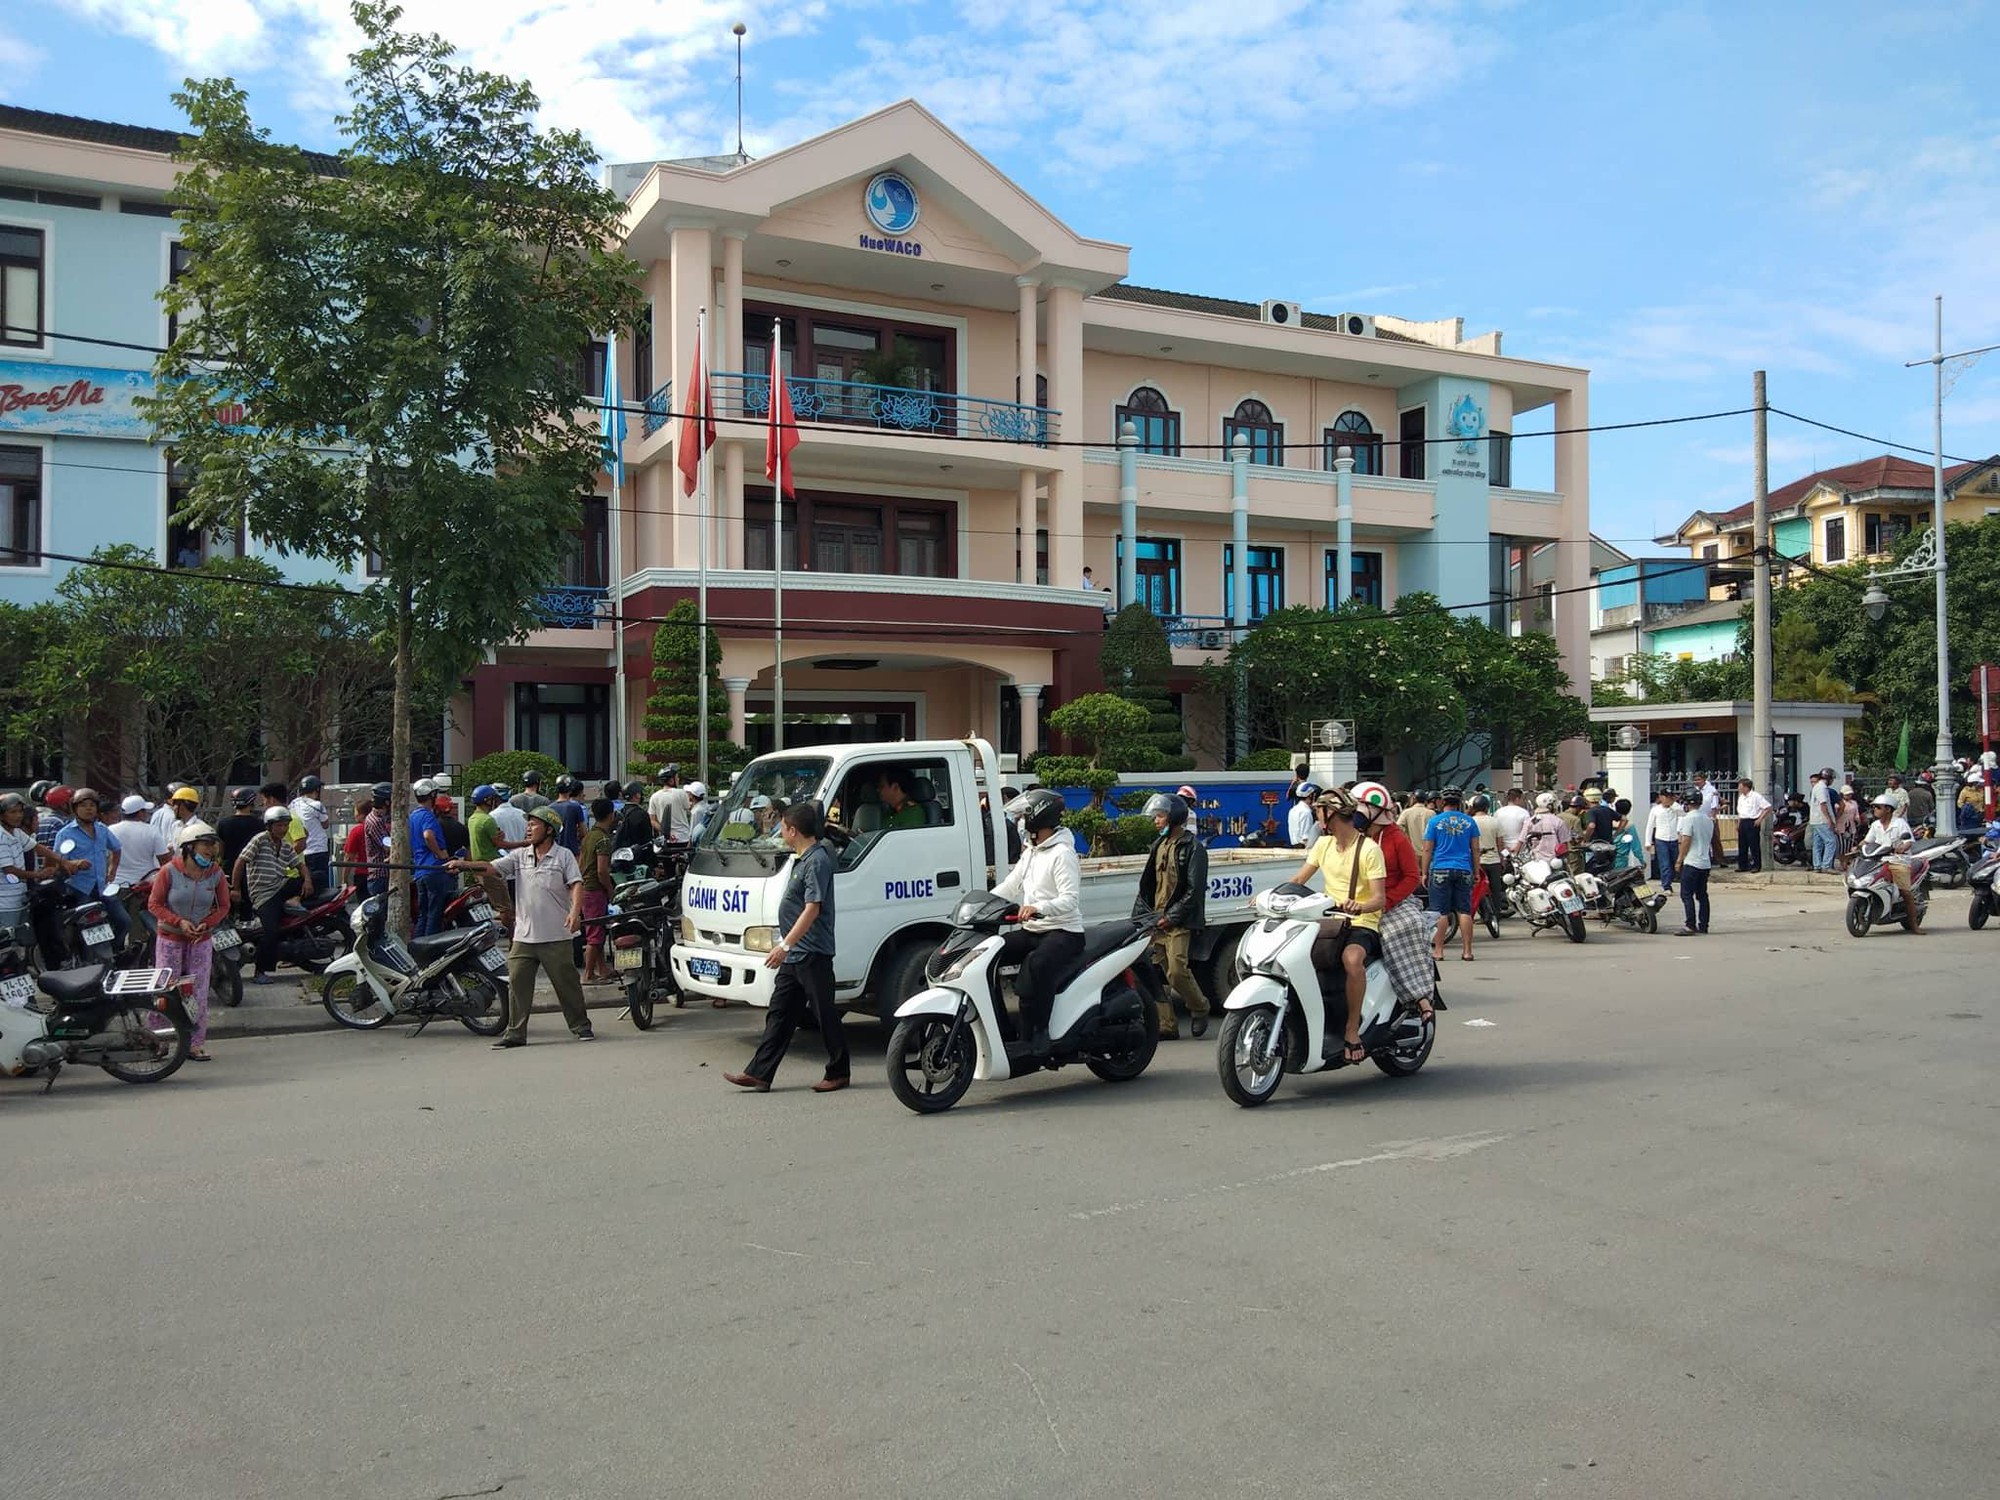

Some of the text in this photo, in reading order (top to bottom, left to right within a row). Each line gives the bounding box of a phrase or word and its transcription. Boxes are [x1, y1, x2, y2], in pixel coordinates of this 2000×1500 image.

[859, 234, 922, 257] HueWACO
[688, 879, 750, 913] CẢNH SÁT
[885, 879, 933, 900] POLICE
